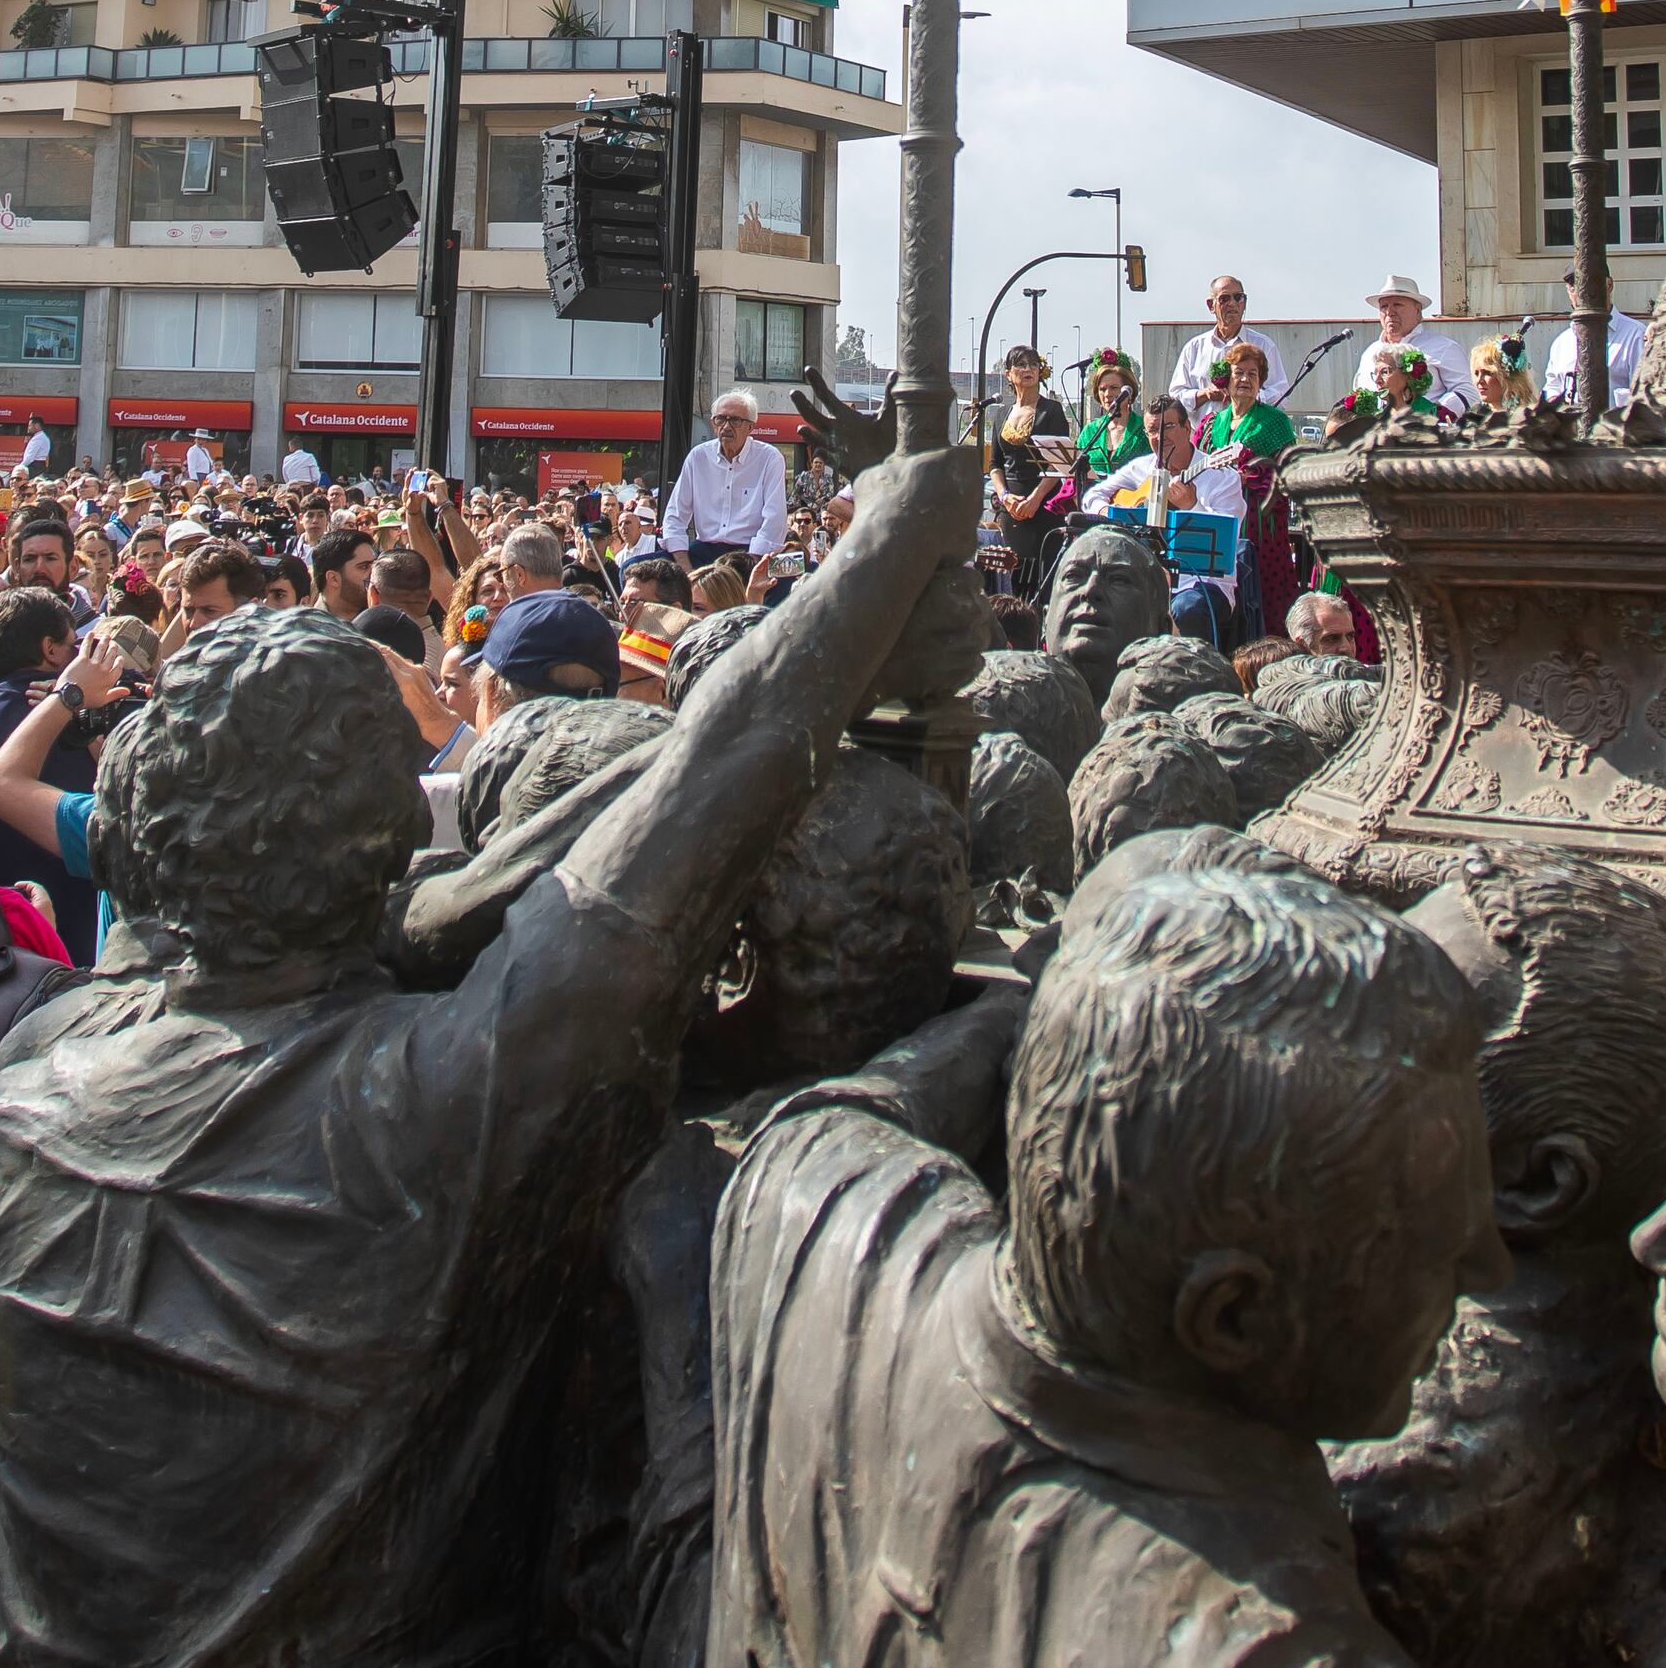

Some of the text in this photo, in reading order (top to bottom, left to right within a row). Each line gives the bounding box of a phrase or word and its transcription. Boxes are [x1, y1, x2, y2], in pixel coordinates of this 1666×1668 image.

[124, 412, 186, 421] Catalana Occidente
[310, 414, 409, 426] Catalana Occidente
[488, 421, 555, 431] Catalana Occidente
